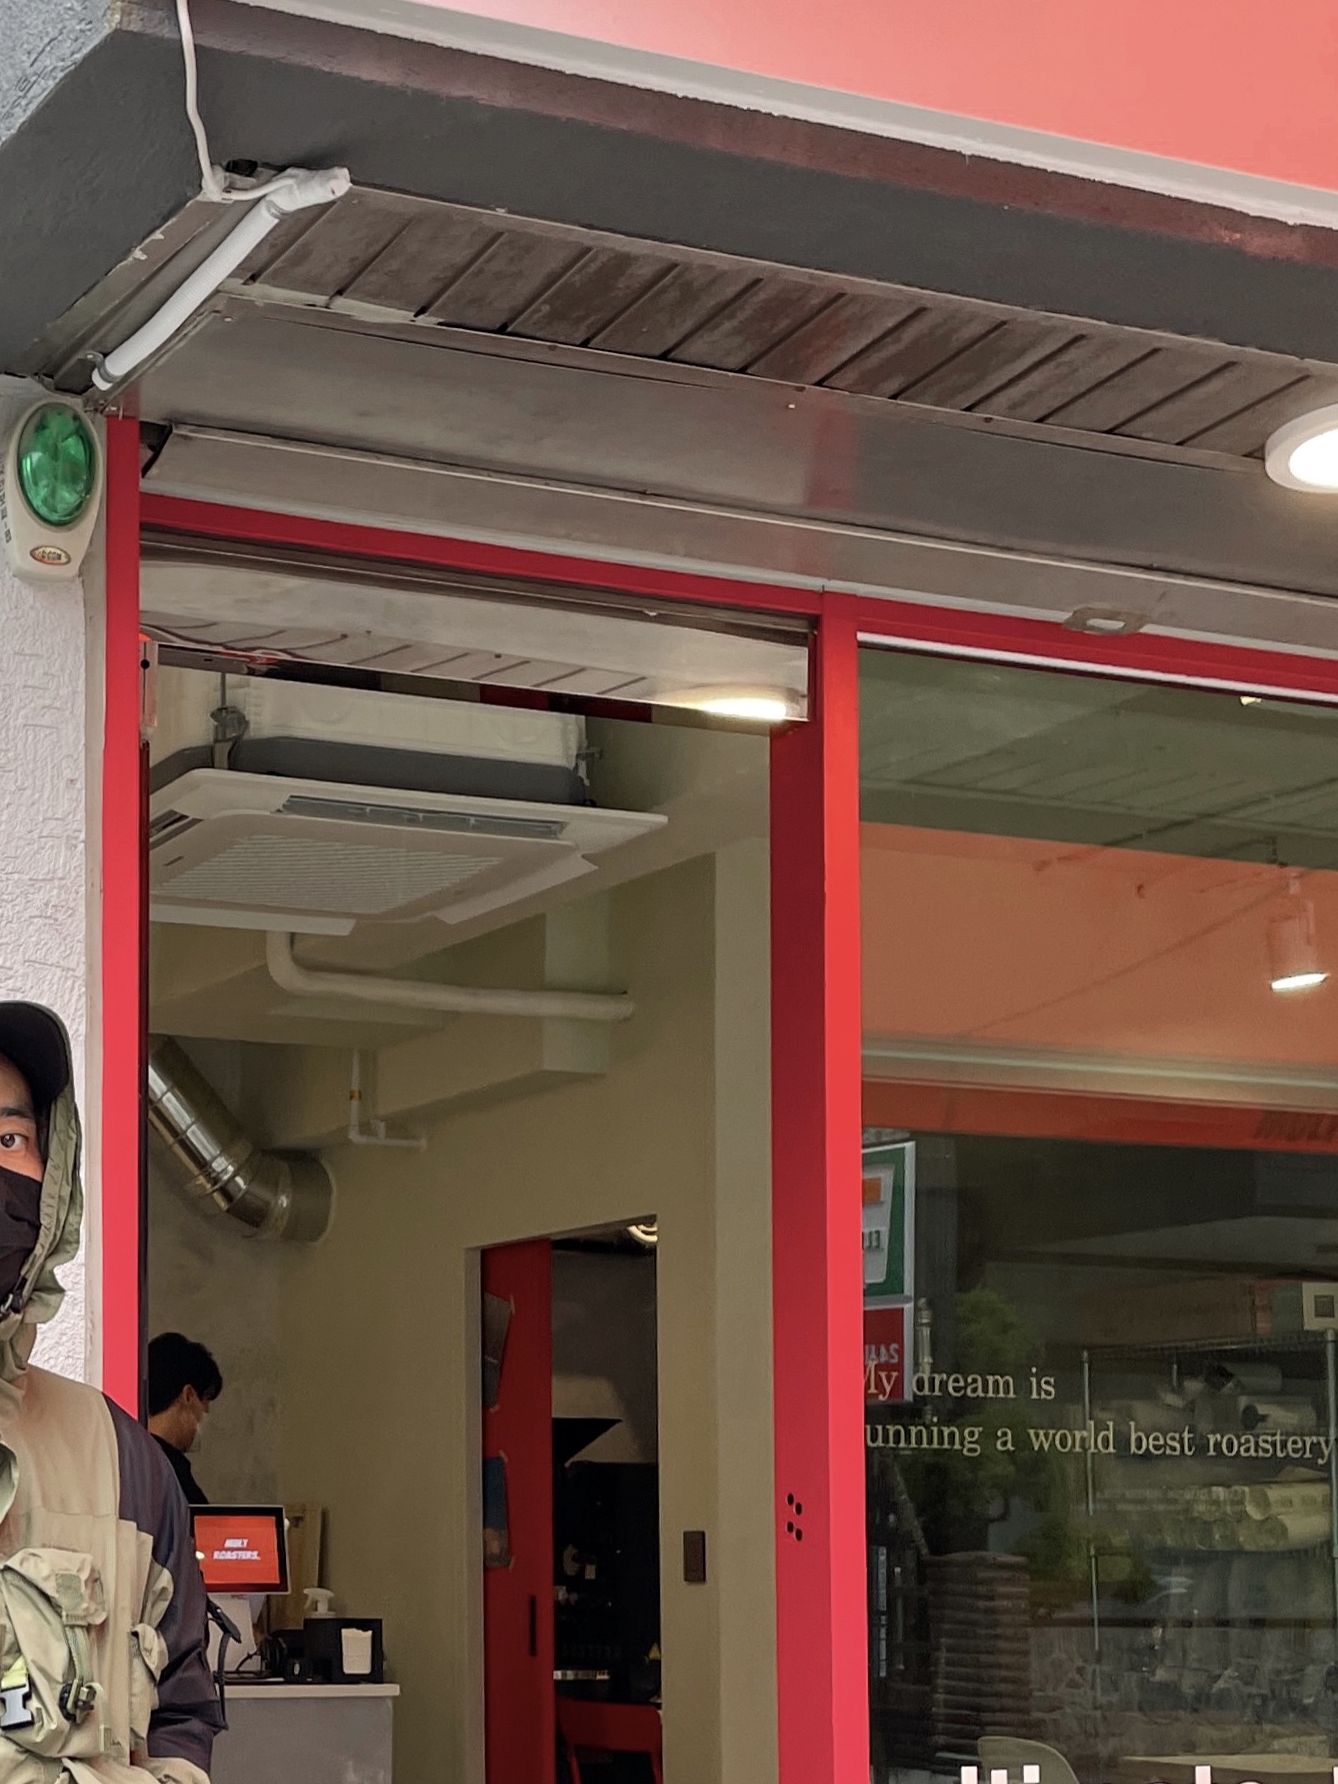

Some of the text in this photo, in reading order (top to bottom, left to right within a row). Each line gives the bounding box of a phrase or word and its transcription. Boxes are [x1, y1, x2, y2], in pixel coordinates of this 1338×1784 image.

[913, 1371, 1016, 1399] dream
[1029, 1367, 1056, 1400] is
[996, 1427, 1015, 1451] a
[1028, 1420, 1116, 1454] world
[1129, 1421, 1195, 1456] best
[1206, 1429, 1335, 1465] roastery
